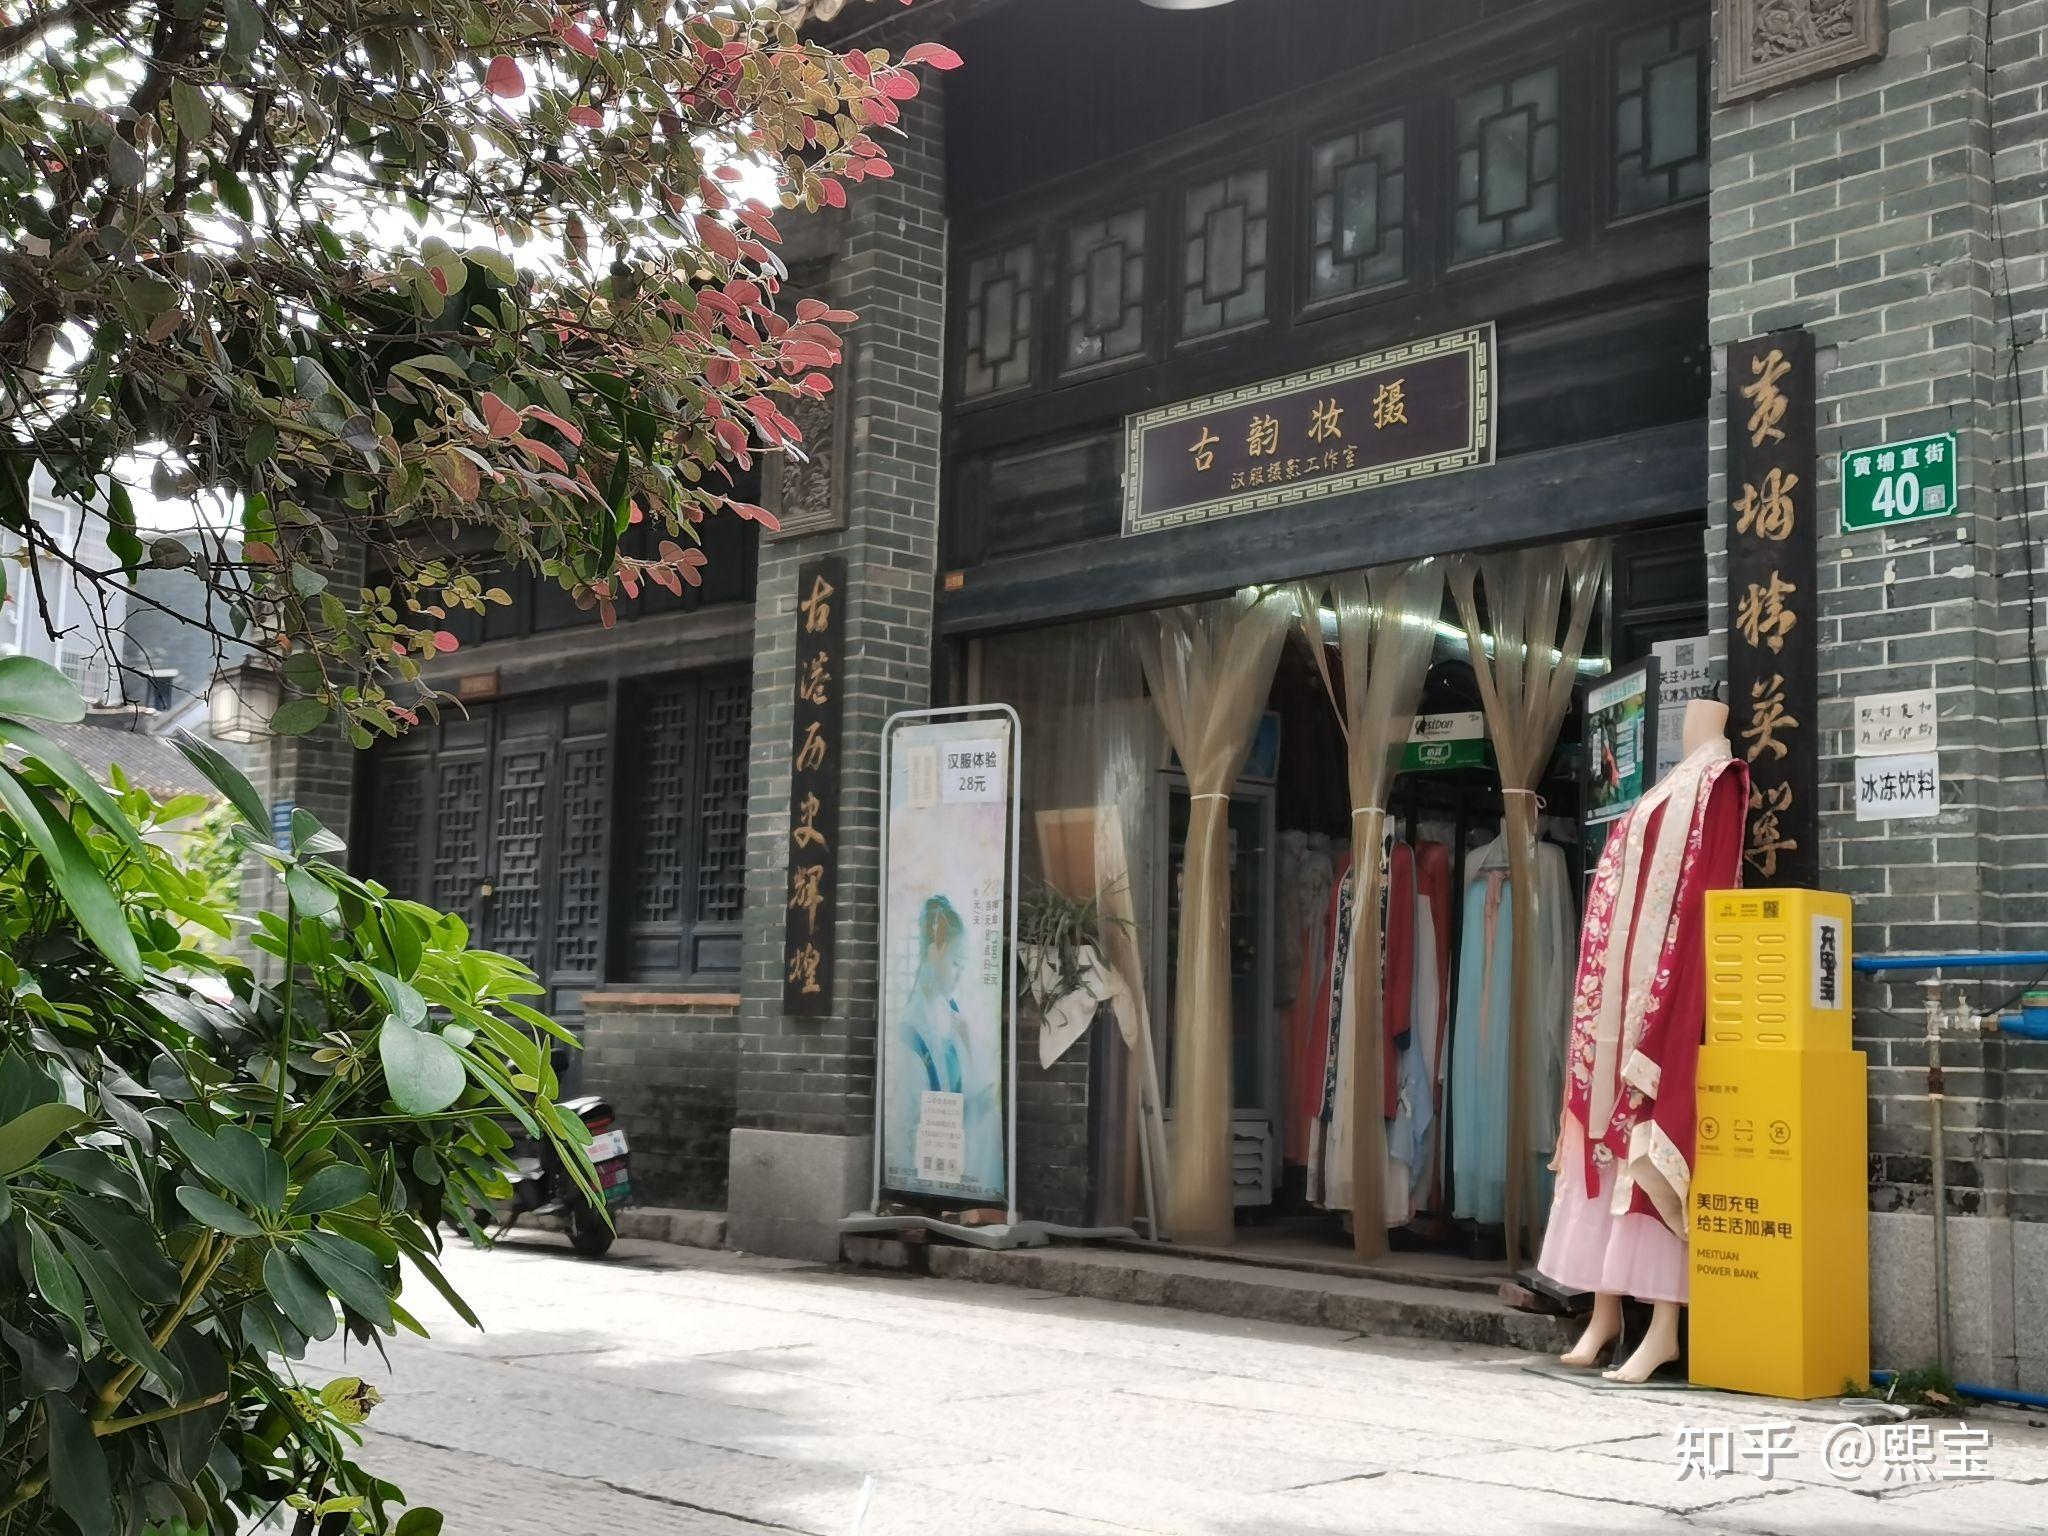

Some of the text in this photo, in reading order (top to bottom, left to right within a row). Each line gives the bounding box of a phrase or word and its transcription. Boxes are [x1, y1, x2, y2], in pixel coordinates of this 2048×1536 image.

[1187, 378, 1408, 472] 古韵妆摄
[1230, 444, 1359, 490] 汉服摄影工作室
[1853, 442, 1945, 478] 黄埔直街
[1871, 471, 1920, 518] 40
[947, 752, 998, 770] 汉服体验
[958, 775, 987, 793] 28元
[1861, 768, 1936, 803] 冰冻饮料
[1697, 1193, 1760, 1215] 美团充电
[1697, 1214, 1793, 1240] 给生活加满电
[1697, 1248, 1740, 1262] MEITUAN
[1697, 1263, 1761, 1280] POWER BANK
